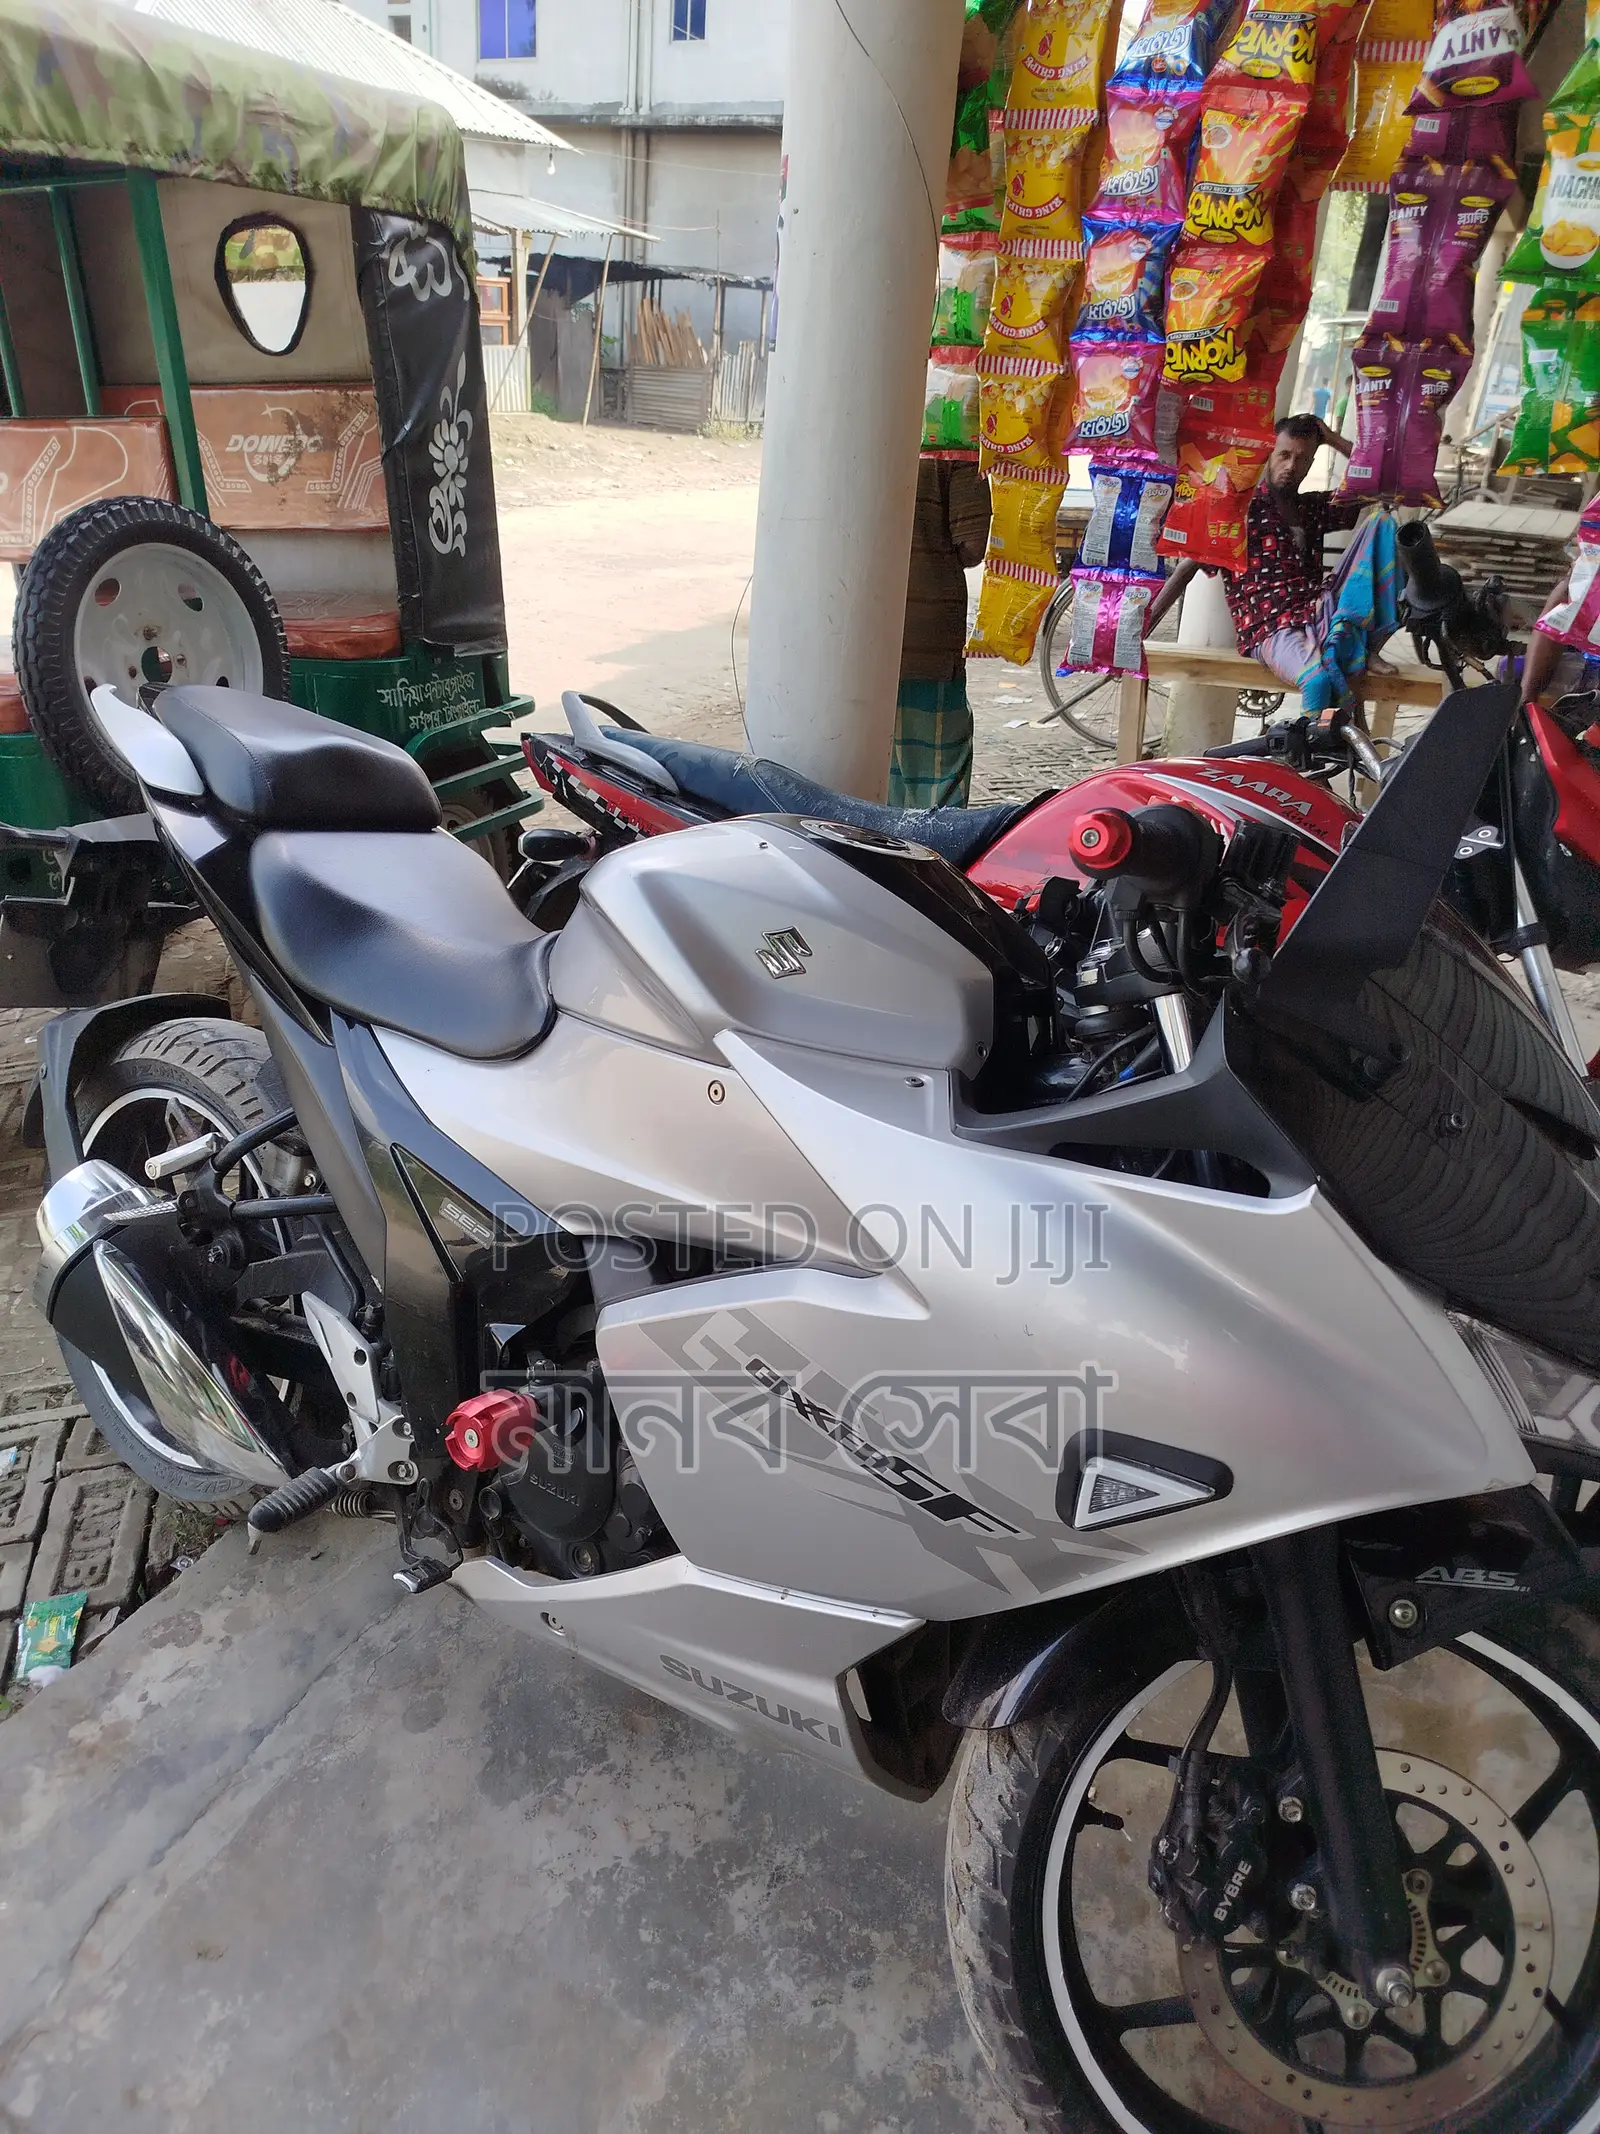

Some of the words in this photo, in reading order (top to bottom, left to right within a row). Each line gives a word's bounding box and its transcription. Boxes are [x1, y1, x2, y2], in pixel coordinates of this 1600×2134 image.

[1025, 55, 1054, 78] CHIPS
[1057, 57, 1089, 80] RING
[1034, 195, 1062, 218] RING
[1019, 319, 1047, 337] RING
[1166, 329, 1234, 371] KORNTO
[1355, 379, 1392, 395] SLANTY
[1007, 435, 1034, 453] RING
[1195, 767, 1313, 816] ZAARA
[443, 1203, 491, 1238] SEP
[1415, 1566, 1521, 1587] ABS
[659, 1653, 843, 1749] SUZUKI
[1213, 1859, 1253, 1923] BYBRE
